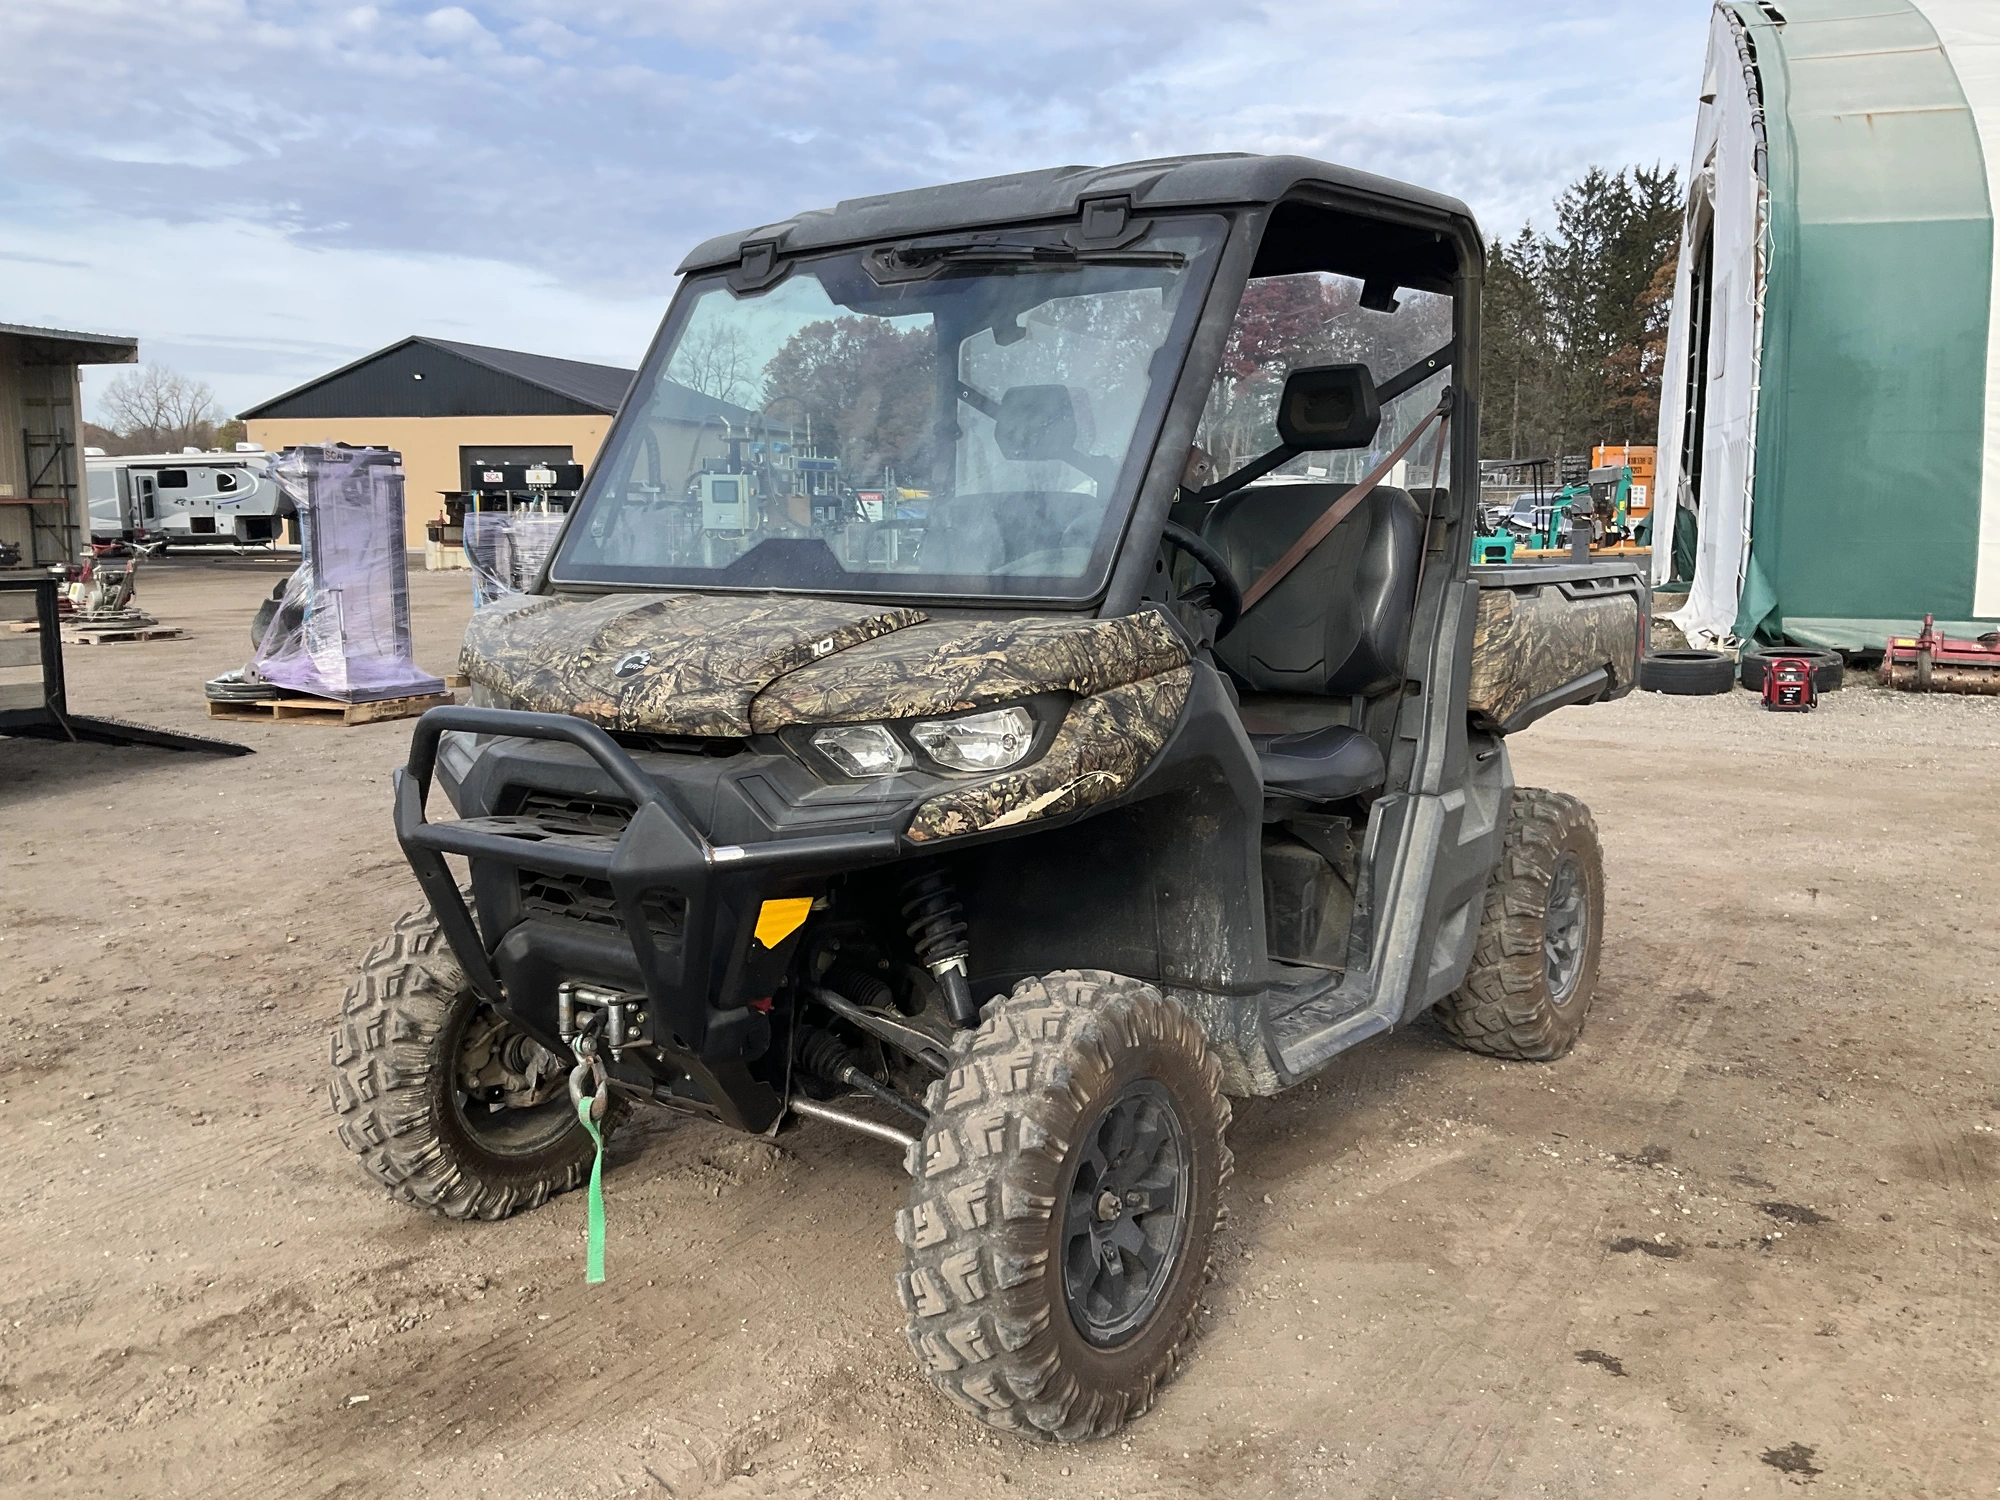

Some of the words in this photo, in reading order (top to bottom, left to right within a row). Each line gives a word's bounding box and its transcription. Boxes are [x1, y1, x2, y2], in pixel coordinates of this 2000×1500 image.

[325, 450, 343, 460] SCA
[485, 473, 500, 481] SCA
[624, 662, 645, 670] BRP
